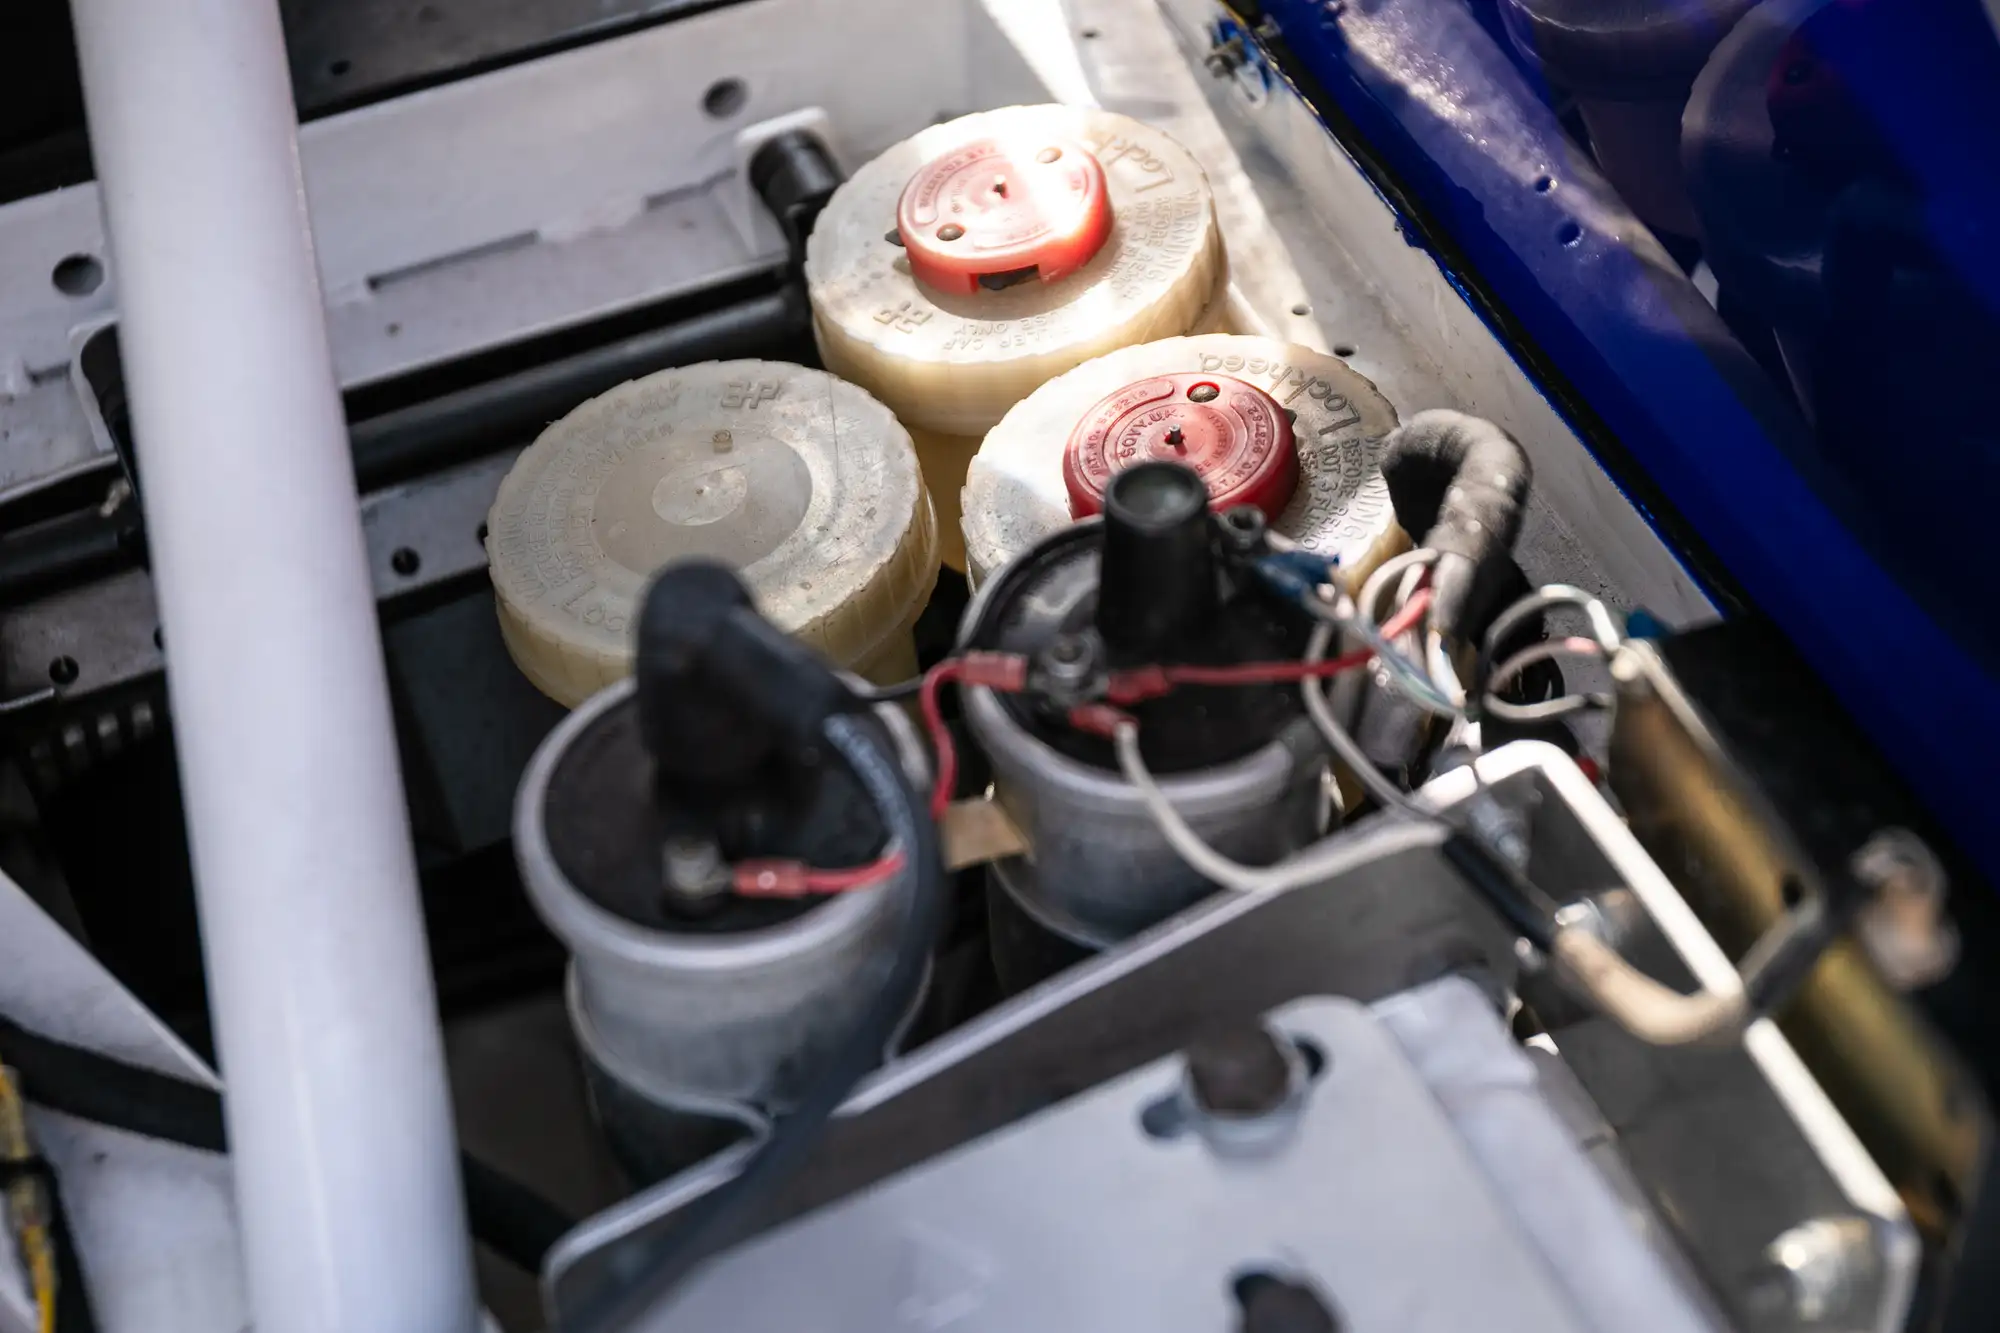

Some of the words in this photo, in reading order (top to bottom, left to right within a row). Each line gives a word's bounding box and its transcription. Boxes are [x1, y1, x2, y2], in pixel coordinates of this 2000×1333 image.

[1199, 352, 1362, 436] Lockheed
[1321, 444, 1341, 473] DOT
[1338, 437, 1363, 499] BEFORE
[1319, 479, 1339, 493] 3
[1303, 506, 1349, 550] REMO
